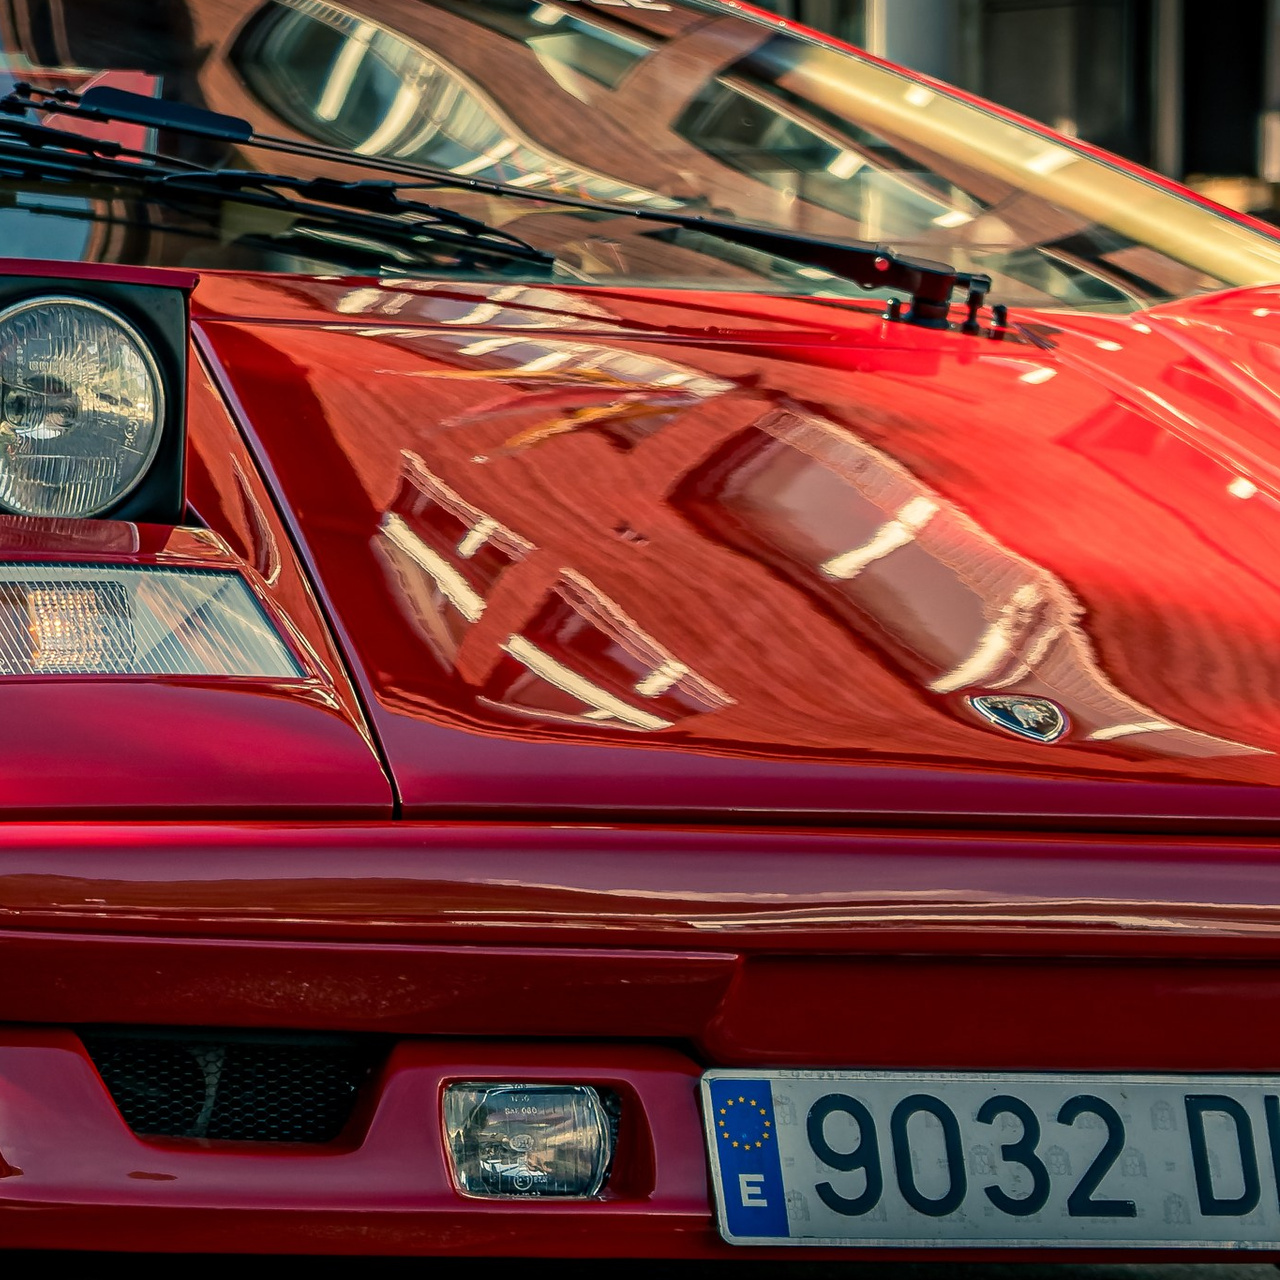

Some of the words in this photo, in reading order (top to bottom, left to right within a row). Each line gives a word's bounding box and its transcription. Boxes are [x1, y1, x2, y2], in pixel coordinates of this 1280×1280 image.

[738, 1174, 768, 1207] E
[806, 1093, 1137, 1217] 9032
[1184, 1094, 1280, 1217] D
